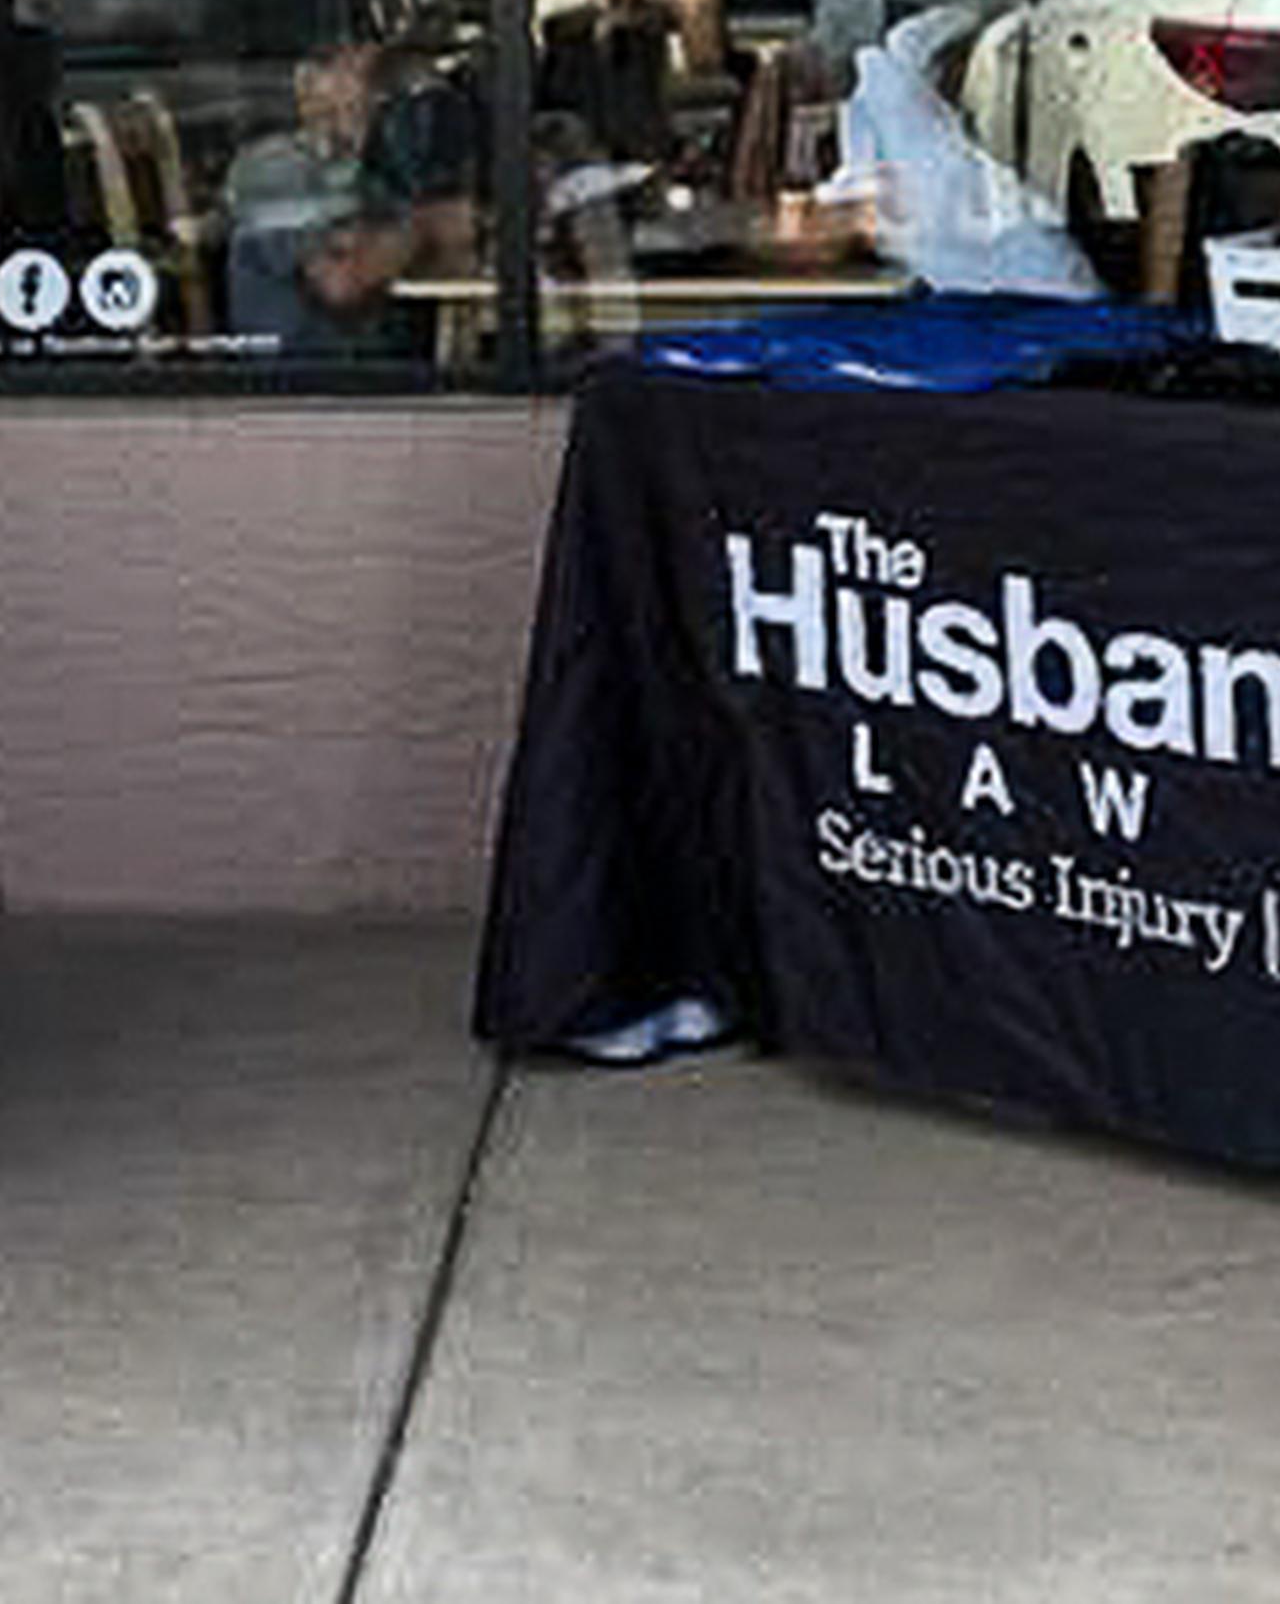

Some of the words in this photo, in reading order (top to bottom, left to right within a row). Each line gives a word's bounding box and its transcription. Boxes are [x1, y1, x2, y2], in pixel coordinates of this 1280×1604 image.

[816, 512, 925, 587] The
[851, 723, 1149, 841] LAW
[817, 809, 1035, 911] Serious
[1051, 855, 1244, 971] Injury
